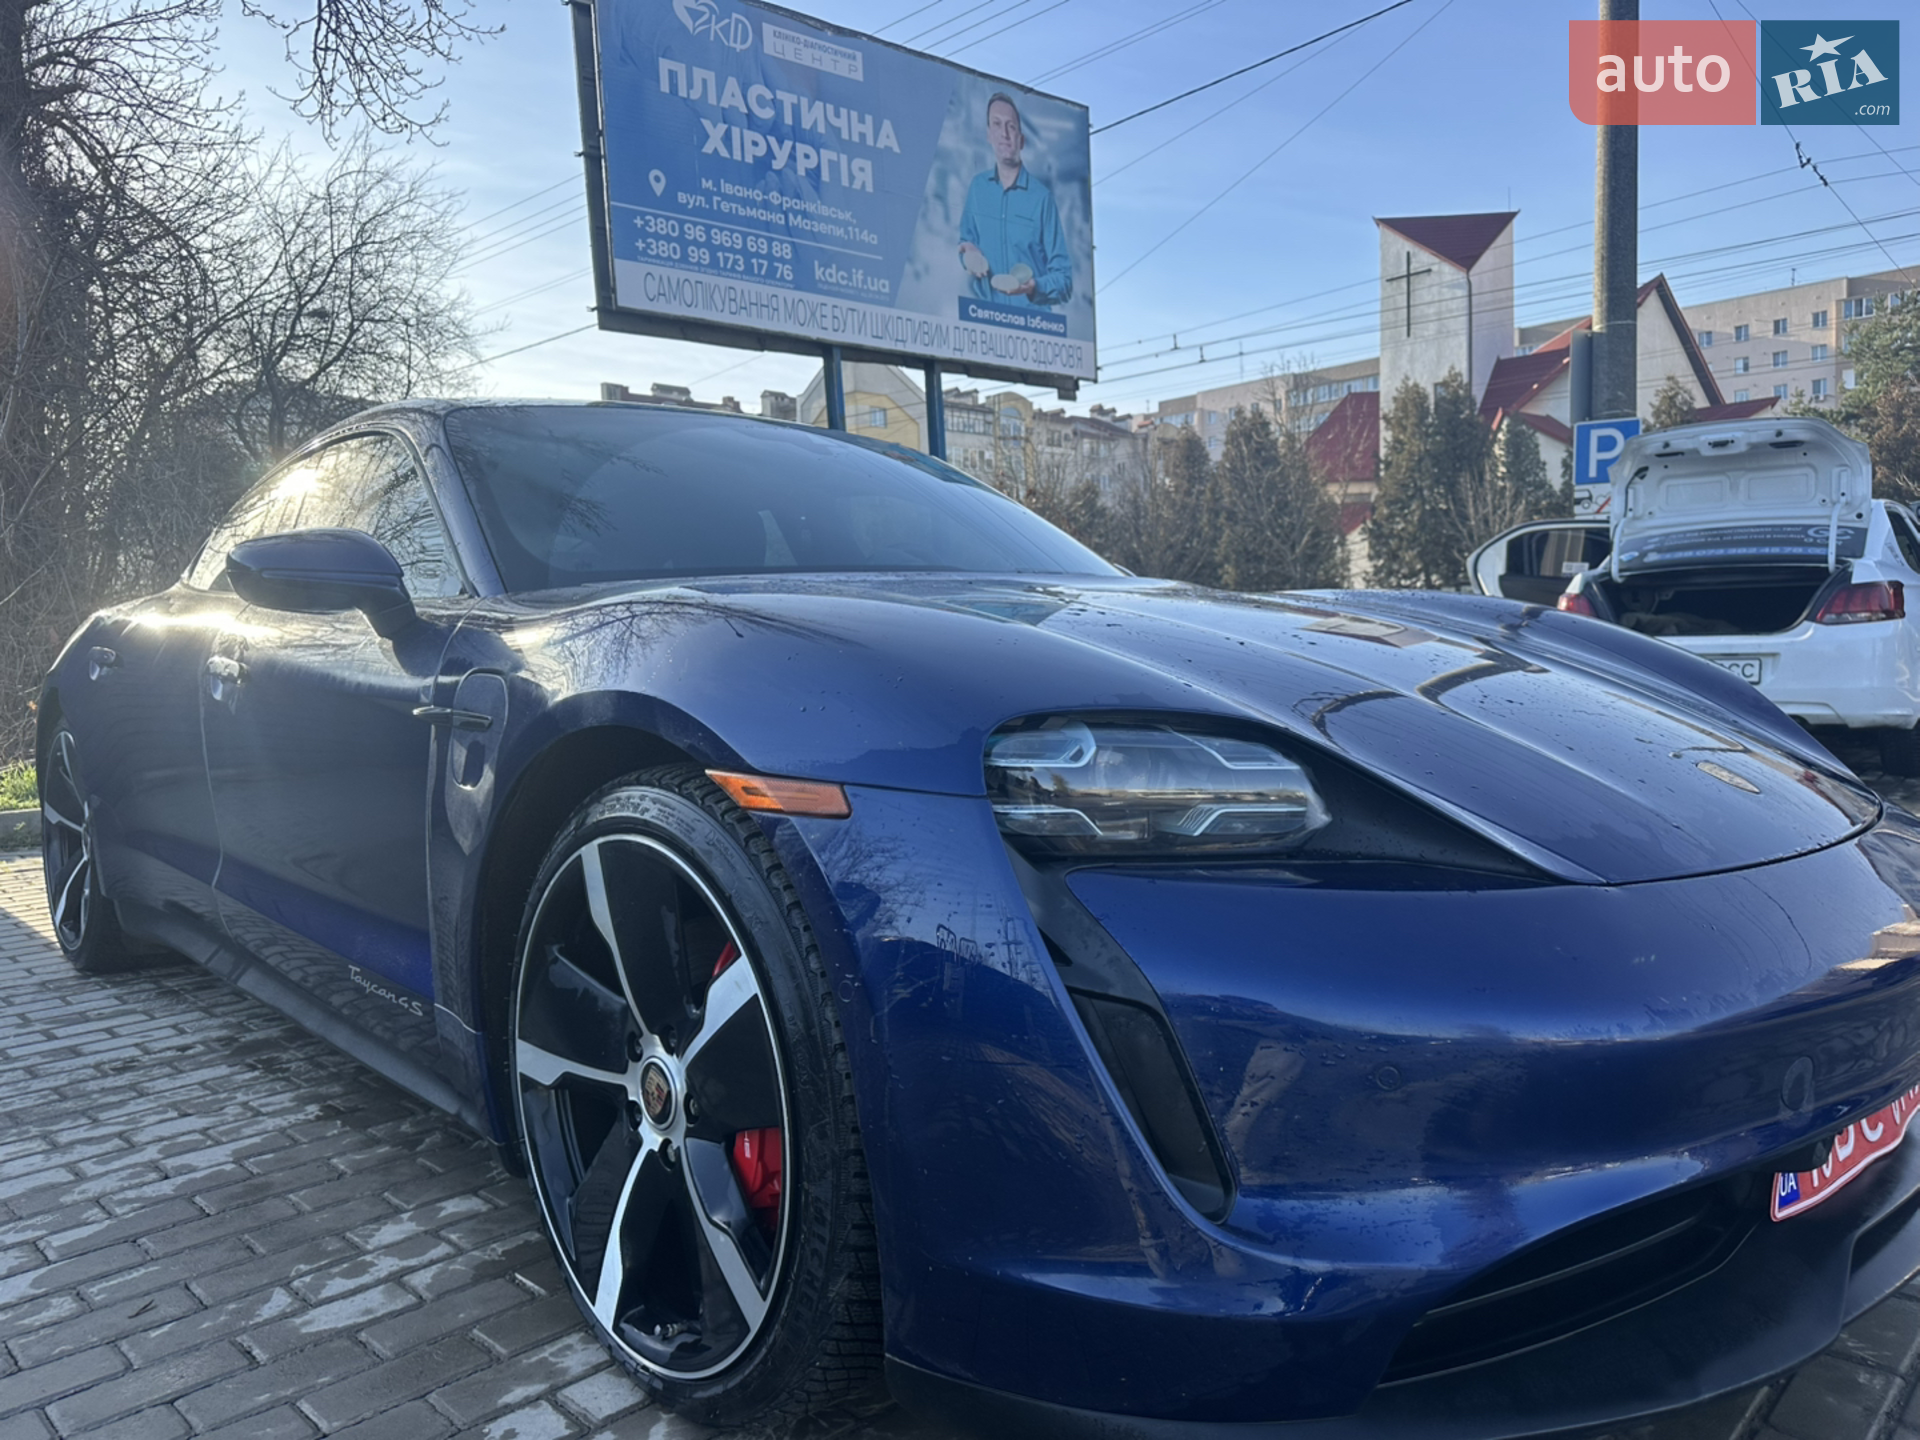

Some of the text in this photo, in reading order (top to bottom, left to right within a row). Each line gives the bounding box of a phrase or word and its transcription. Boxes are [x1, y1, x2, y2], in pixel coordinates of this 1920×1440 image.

[774, 42, 858, 76] ЦЕНТР
[658, 57, 901, 154] ПЛАСТИЧНА
[700, 118, 874, 193] ХІРУРГІЯ
[677, 191, 709, 210] вул.
[712, 196, 786, 226] Гетьмана
[701, 177, 857, 224] м. Івано-Франківськ,
[633, 215, 792, 260] +380 96 969 69 88
[635, 238, 794, 281] +380 99 173 17 76
[814, 260, 890, 294] kdc.if.ua
[643, 272, 781, 323] САМОЛІКУВАННЯ
[783, 297, 829, 332] МОЖЕ
[831, 305, 867, 337] БУТИ
[871, 313, 950, 350] ШКІДЛИВИМ
[952, 325, 977, 357] ДЛЯ
[979, 330, 1030, 364] ВАШОГО
[967, 305, 1066, 334] Святослав Ізбенко
[1588, 427, 1625, 478] P
[348, 964, 398, 1004] Taycan
[1779, 1171, 1797, 1197] UA
